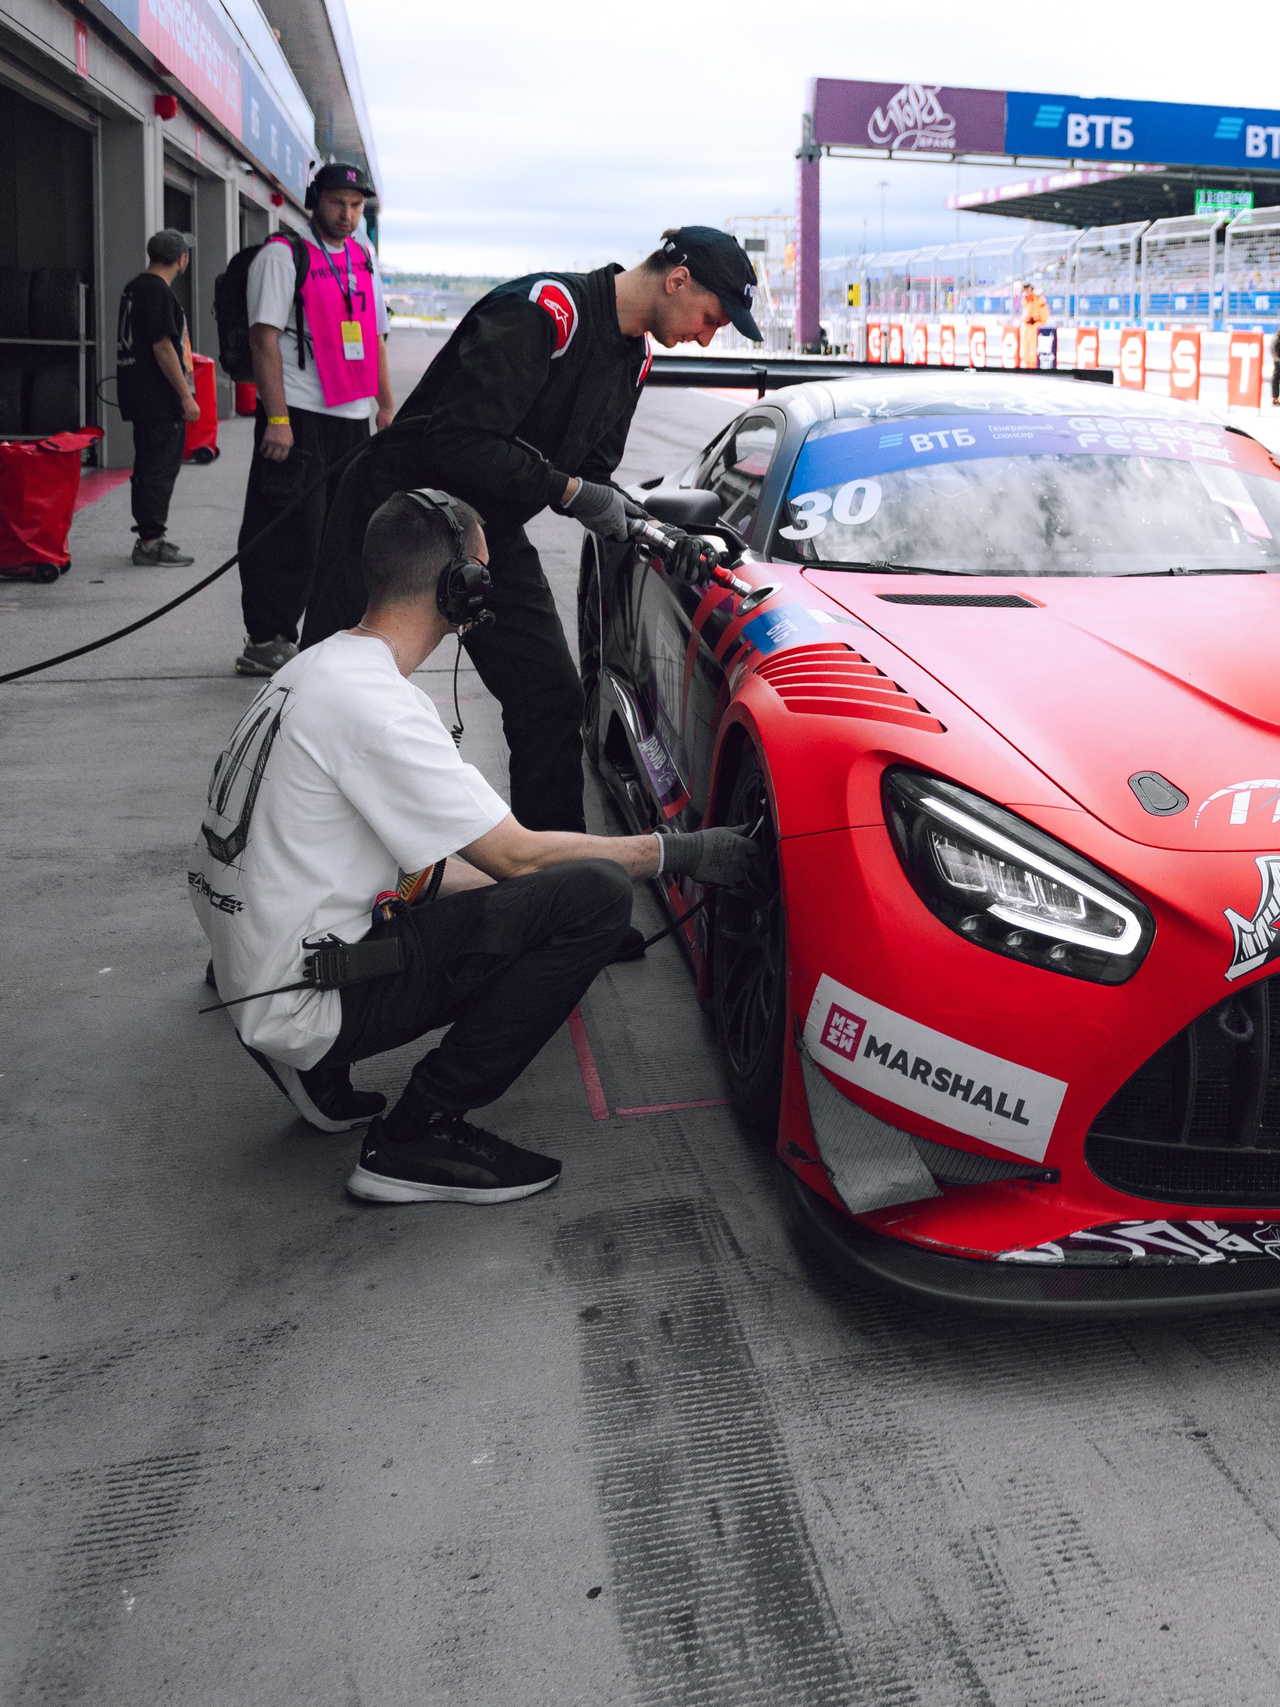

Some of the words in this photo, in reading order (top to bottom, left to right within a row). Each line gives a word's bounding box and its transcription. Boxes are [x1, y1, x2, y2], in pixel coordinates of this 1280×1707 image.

[1066, 113, 1134, 151] ВТБ
[310, 262, 373, 280] PRODUTIO
[909, 428, 976, 453] ВТБ
[988, 423, 1054, 434] Генеральный
[992, 430, 1034, 440] спонсор
[779, 479, 882, 541] 30
[766, 618, 799, 643] ВТБ
[863, 1034, 1030, 1127] MARSHALL
